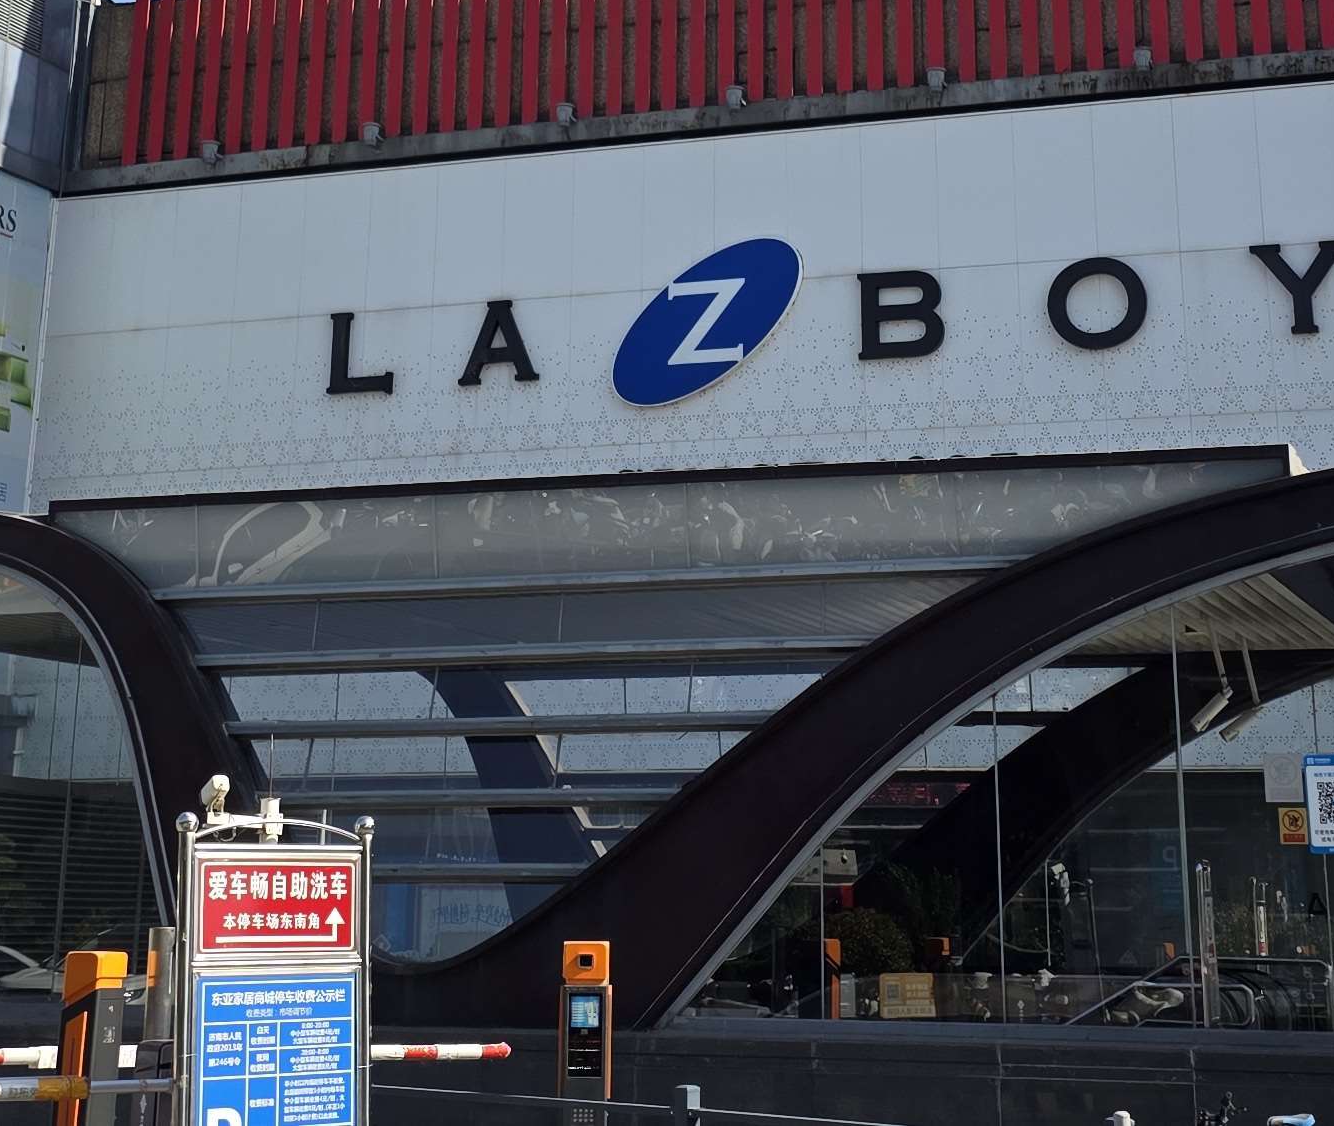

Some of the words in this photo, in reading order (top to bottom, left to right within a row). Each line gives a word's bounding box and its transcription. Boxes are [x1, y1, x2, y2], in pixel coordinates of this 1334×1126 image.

[208, 870, 348, 902] 爱车畅自助洗车
[222, 912, 321, 932] 本停车场东南角
[211, 988, 347, 1007] 东亚家居商城停车收费公示栏
